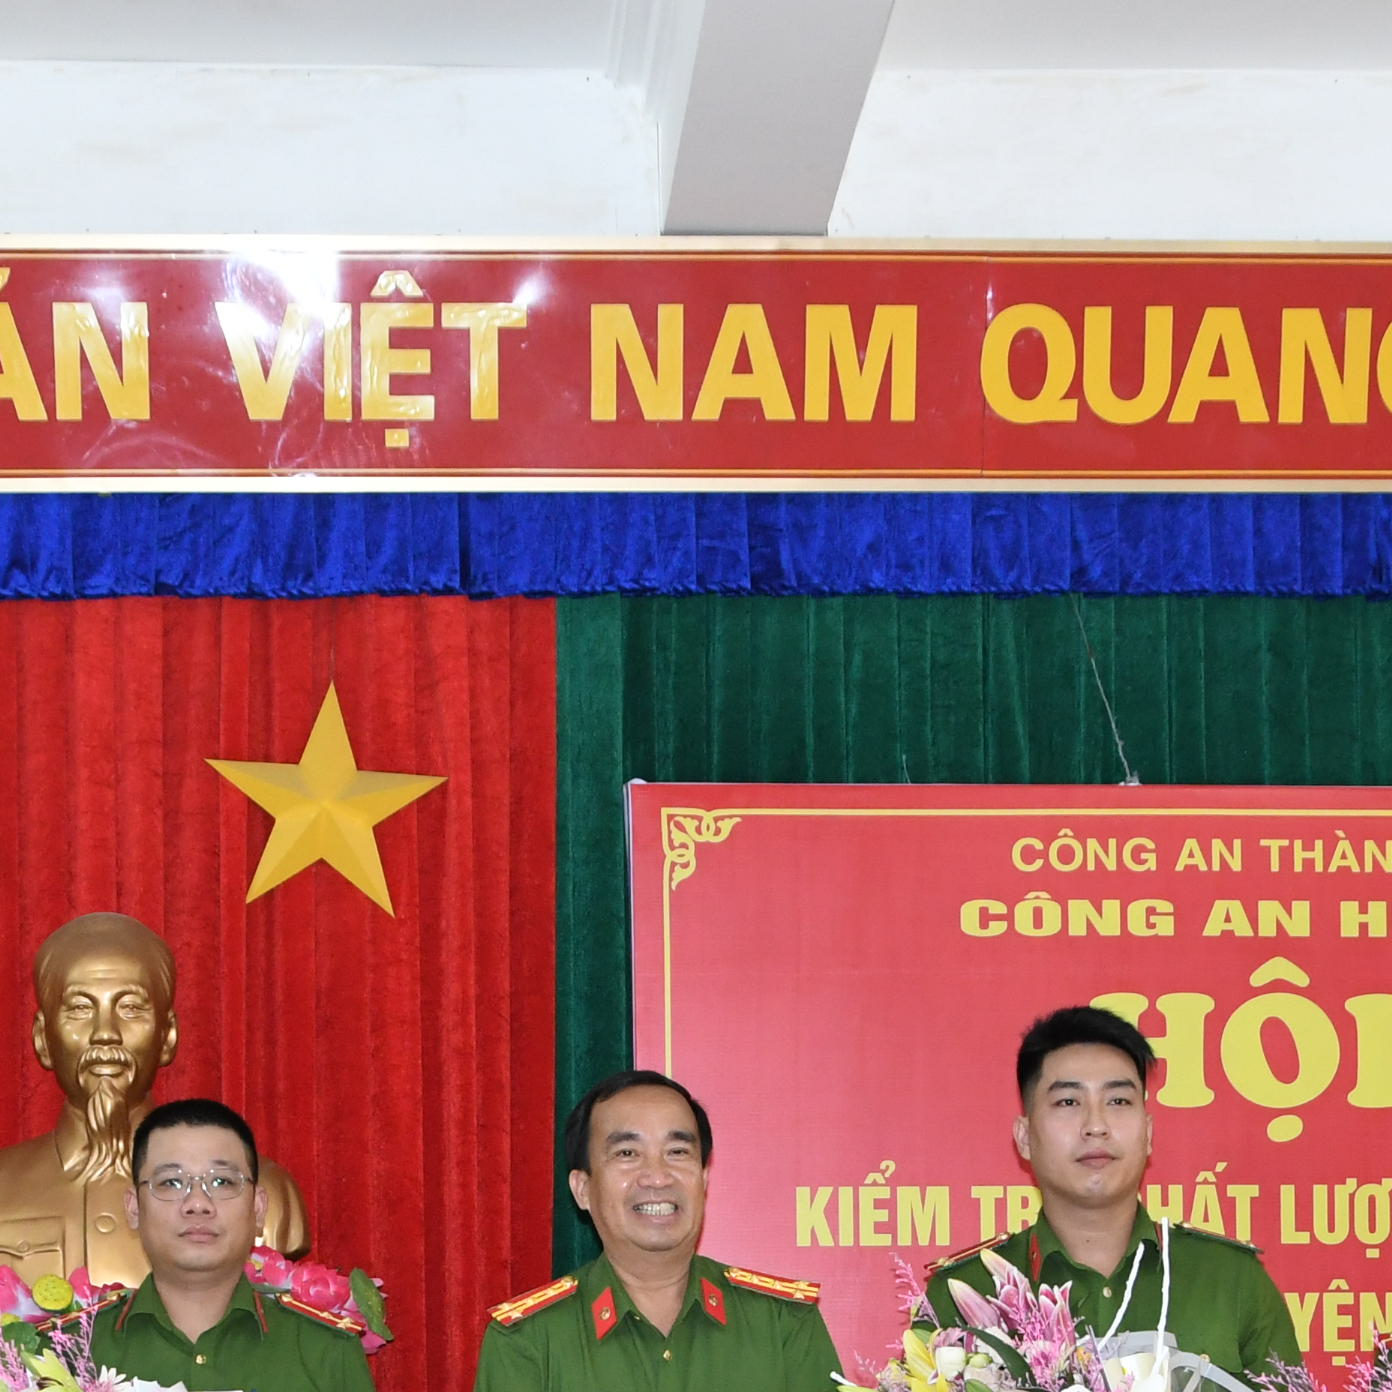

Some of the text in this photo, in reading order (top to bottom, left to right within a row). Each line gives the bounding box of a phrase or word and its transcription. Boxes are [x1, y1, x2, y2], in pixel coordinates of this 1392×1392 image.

[214, 270, 528, 449] VIỆT
[590, 303, 918, 422] NAM
[1010, 826, 1158, 874] CÔNG
[1174, 838, 1243, 873] AN
[958, 890, 1176, 939] CÔNG
[1201, 898, 1312, 938] AN
[795, 1159, 951, 1247] KIỂM
[971, 1184, 1044, 1243] TR
[1137, 1161, 1261, 1244] HẤT
